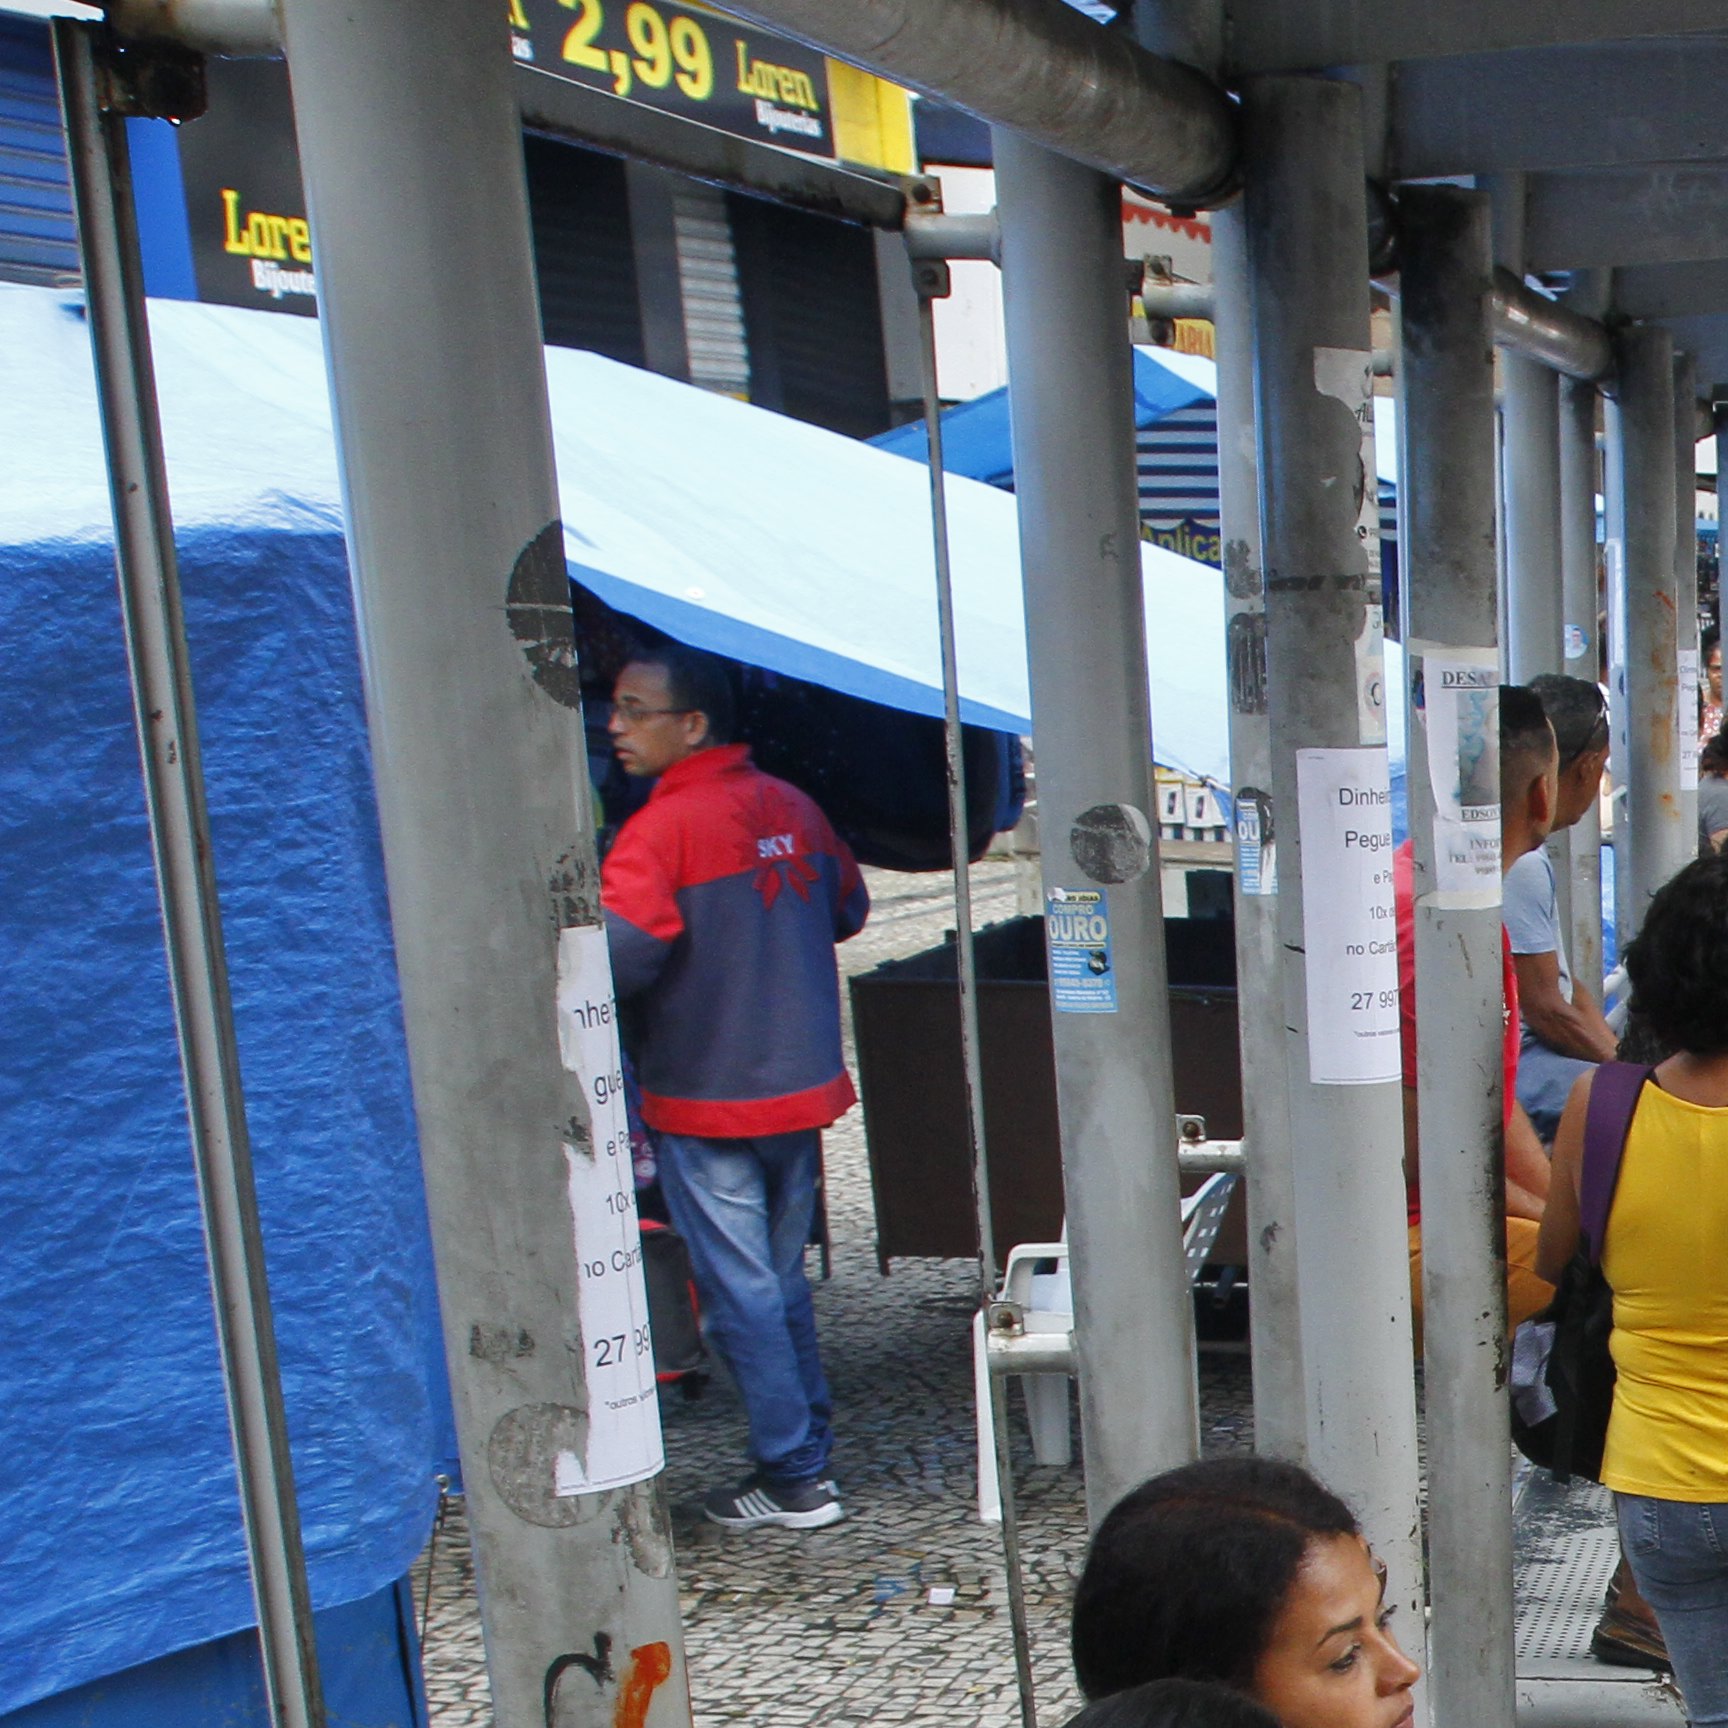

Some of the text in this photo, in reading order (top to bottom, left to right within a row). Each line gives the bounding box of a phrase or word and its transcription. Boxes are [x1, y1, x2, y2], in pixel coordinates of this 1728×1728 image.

[562, 0, 714, 100] 2,99
[735, 39, 819, 111] Loren
[757, 833, 794, 858] SKY
[1049, 915, 1107, 941] OURO
[1346, 944, 1364, 956] no
[1351, 992, 1373, 1010] 27
[607, 1141, 617, 1157] e
[594, 1335, 626, 1368] 27
